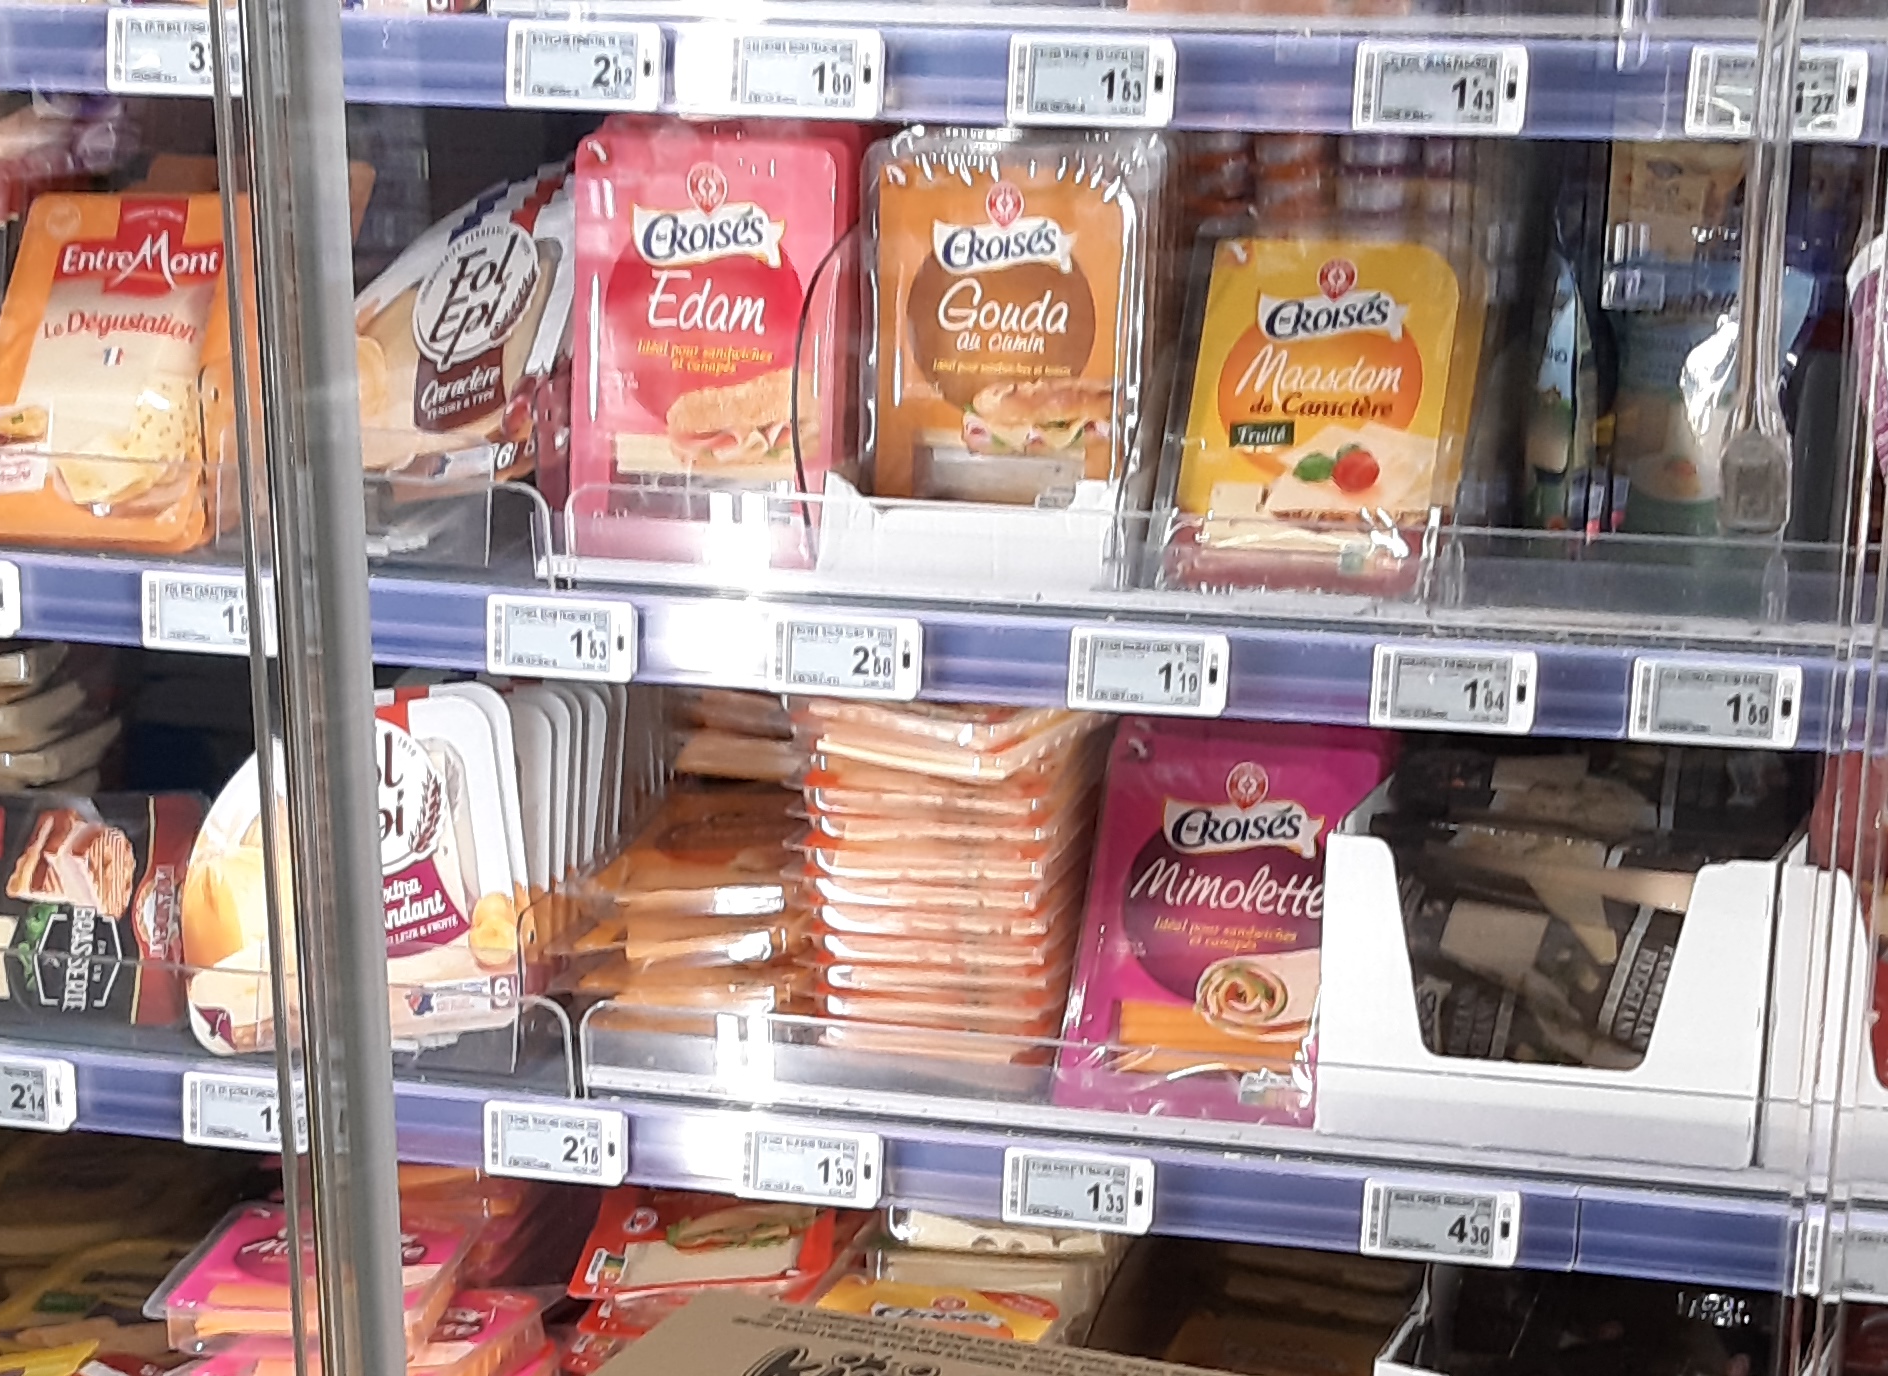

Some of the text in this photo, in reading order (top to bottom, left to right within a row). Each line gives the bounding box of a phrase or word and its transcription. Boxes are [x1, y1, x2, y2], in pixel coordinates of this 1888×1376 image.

[646, 268, 766, 336] Edam
[937, 277, 1069, 335] Gouda
[1233, 341, 1402, 403] Maasdam
[1129, 857, 1324, 919] Mimolette
